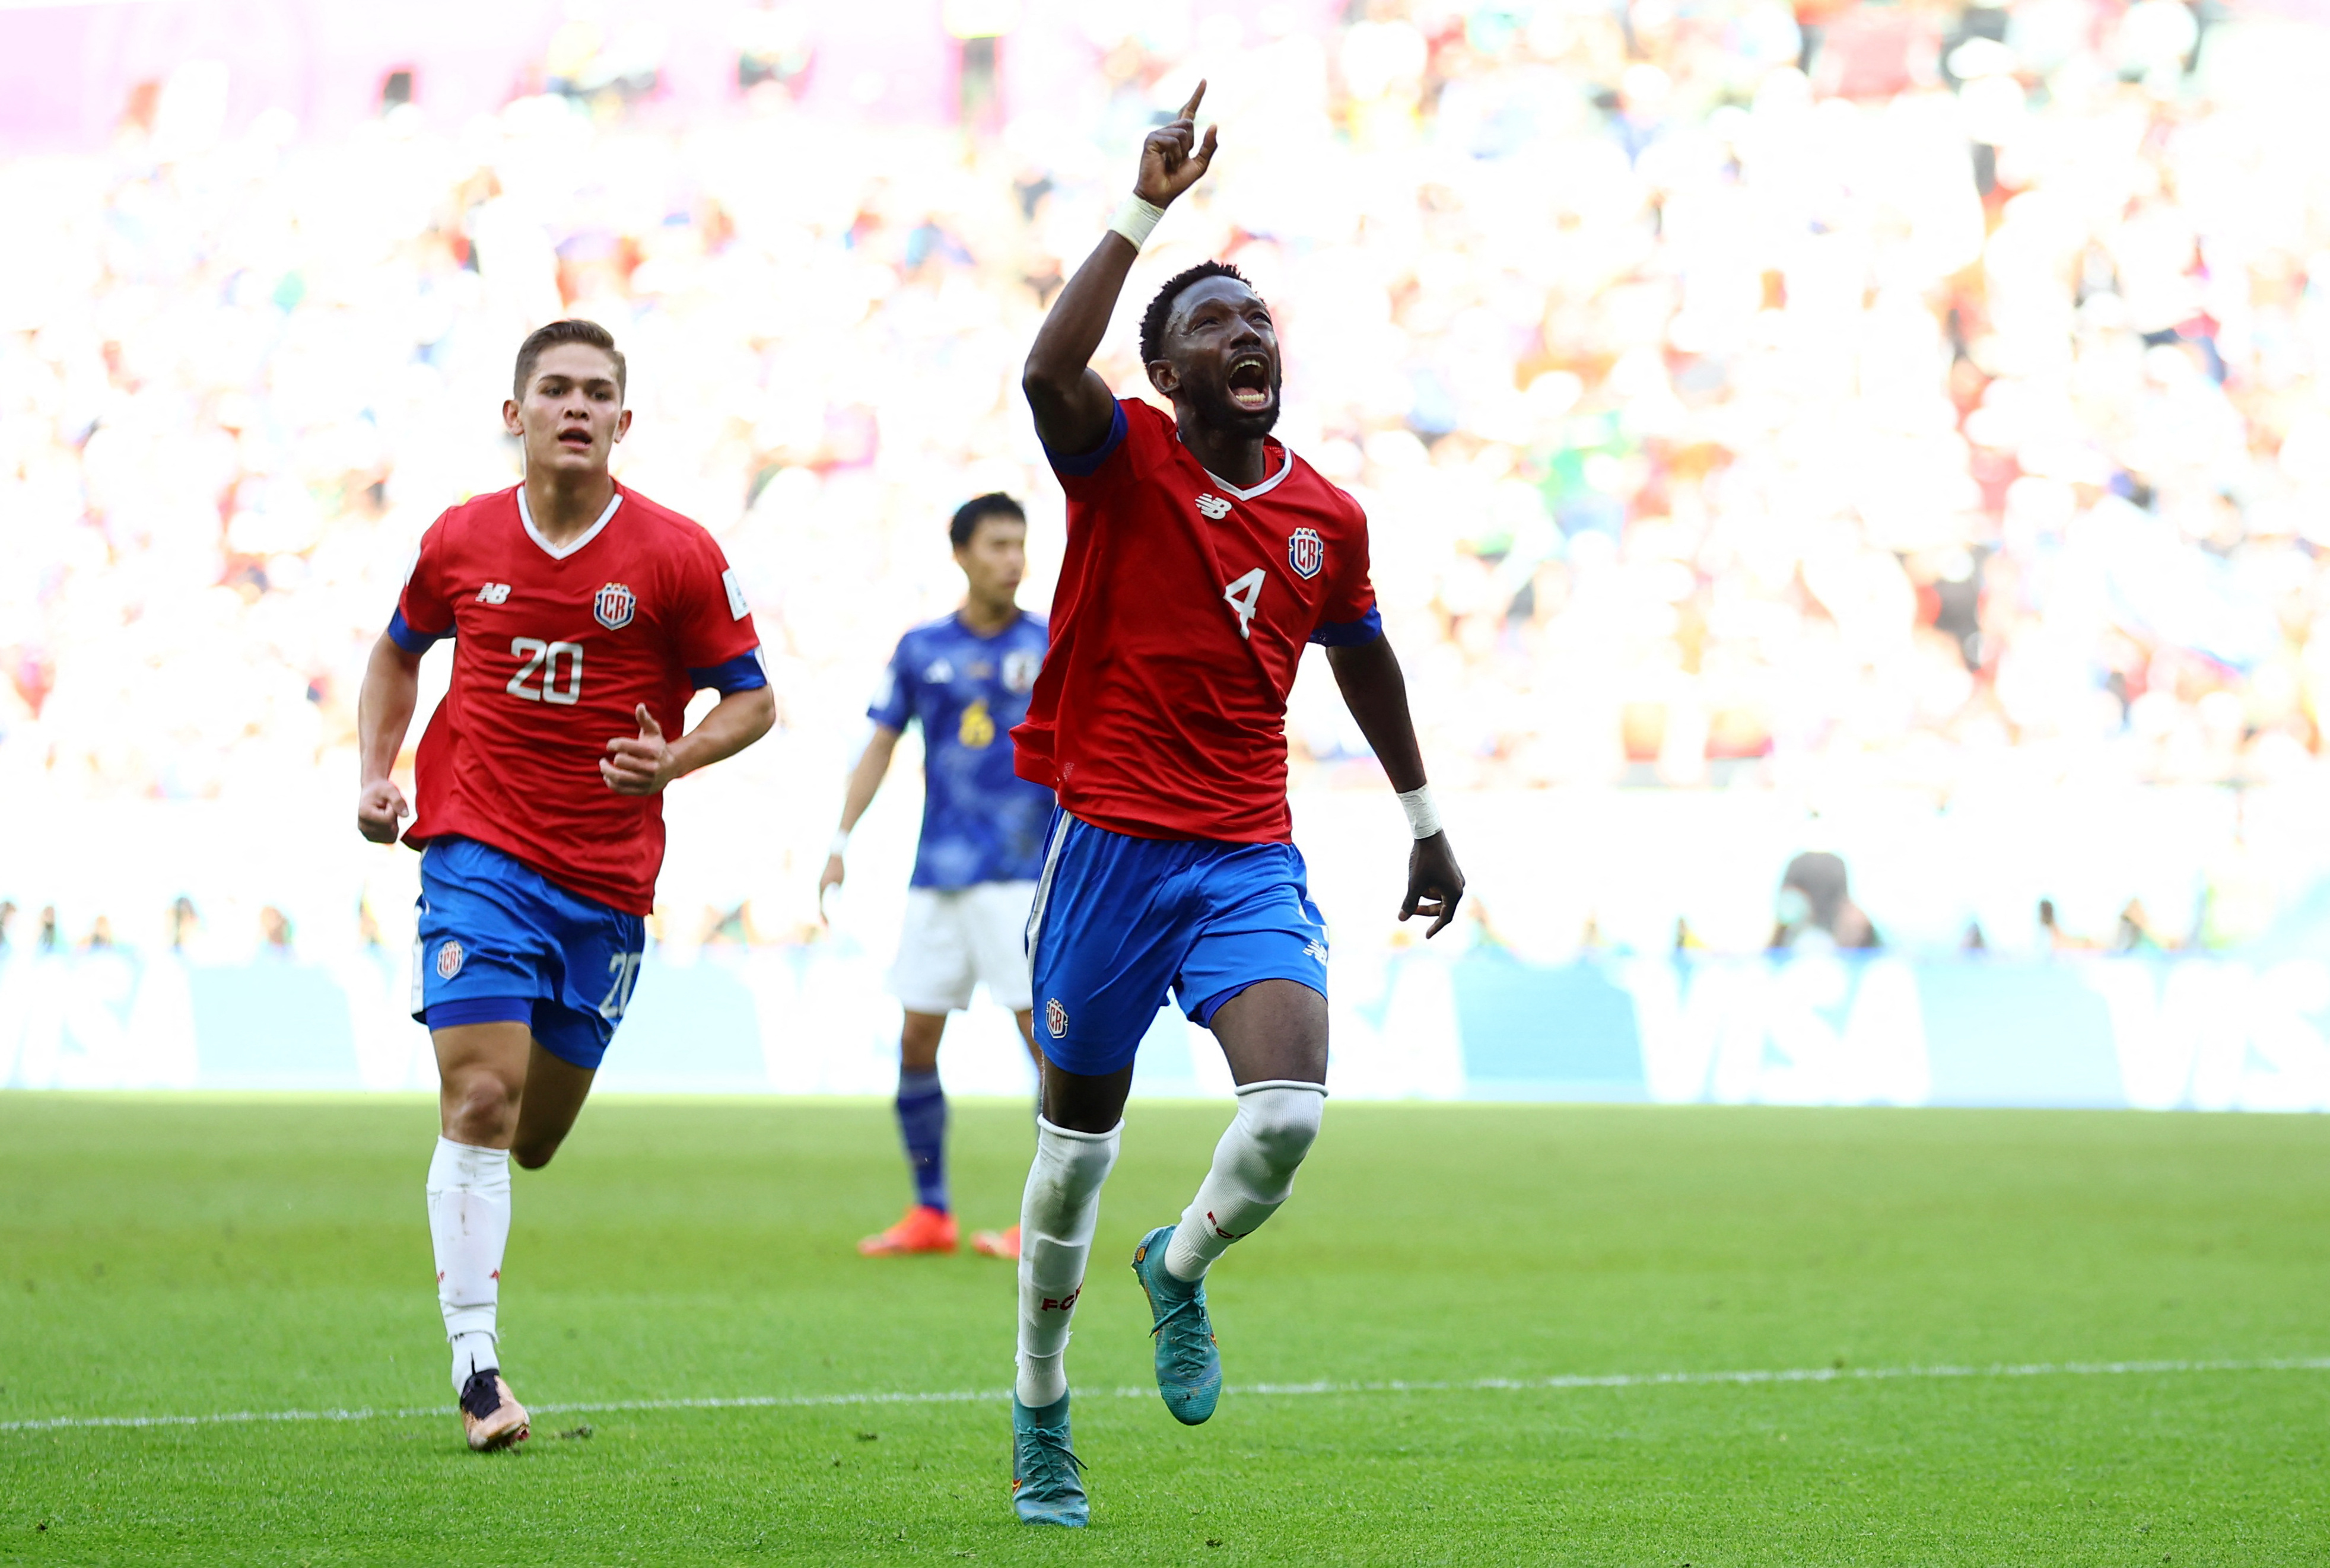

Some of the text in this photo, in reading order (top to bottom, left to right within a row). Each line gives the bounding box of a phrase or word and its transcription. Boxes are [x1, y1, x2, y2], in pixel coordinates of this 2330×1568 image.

[1297, 539, 1315, 570] CR
[475, 583, 511, 605] NB
[604, 593, 627, 623] CR
[1223, 567, 1266, 640] 4
[506, 637, 583, 705] 20
[959, 698, 995, 749] 6
[443, 950, 457, 971] CR
[0, 953, 200, 1087] ISA
[1050, 1006, 1062, 1031] CR
[1611, 955, 1933, 1102] VISA
[2077, 956, 2330, 1108] VIS
